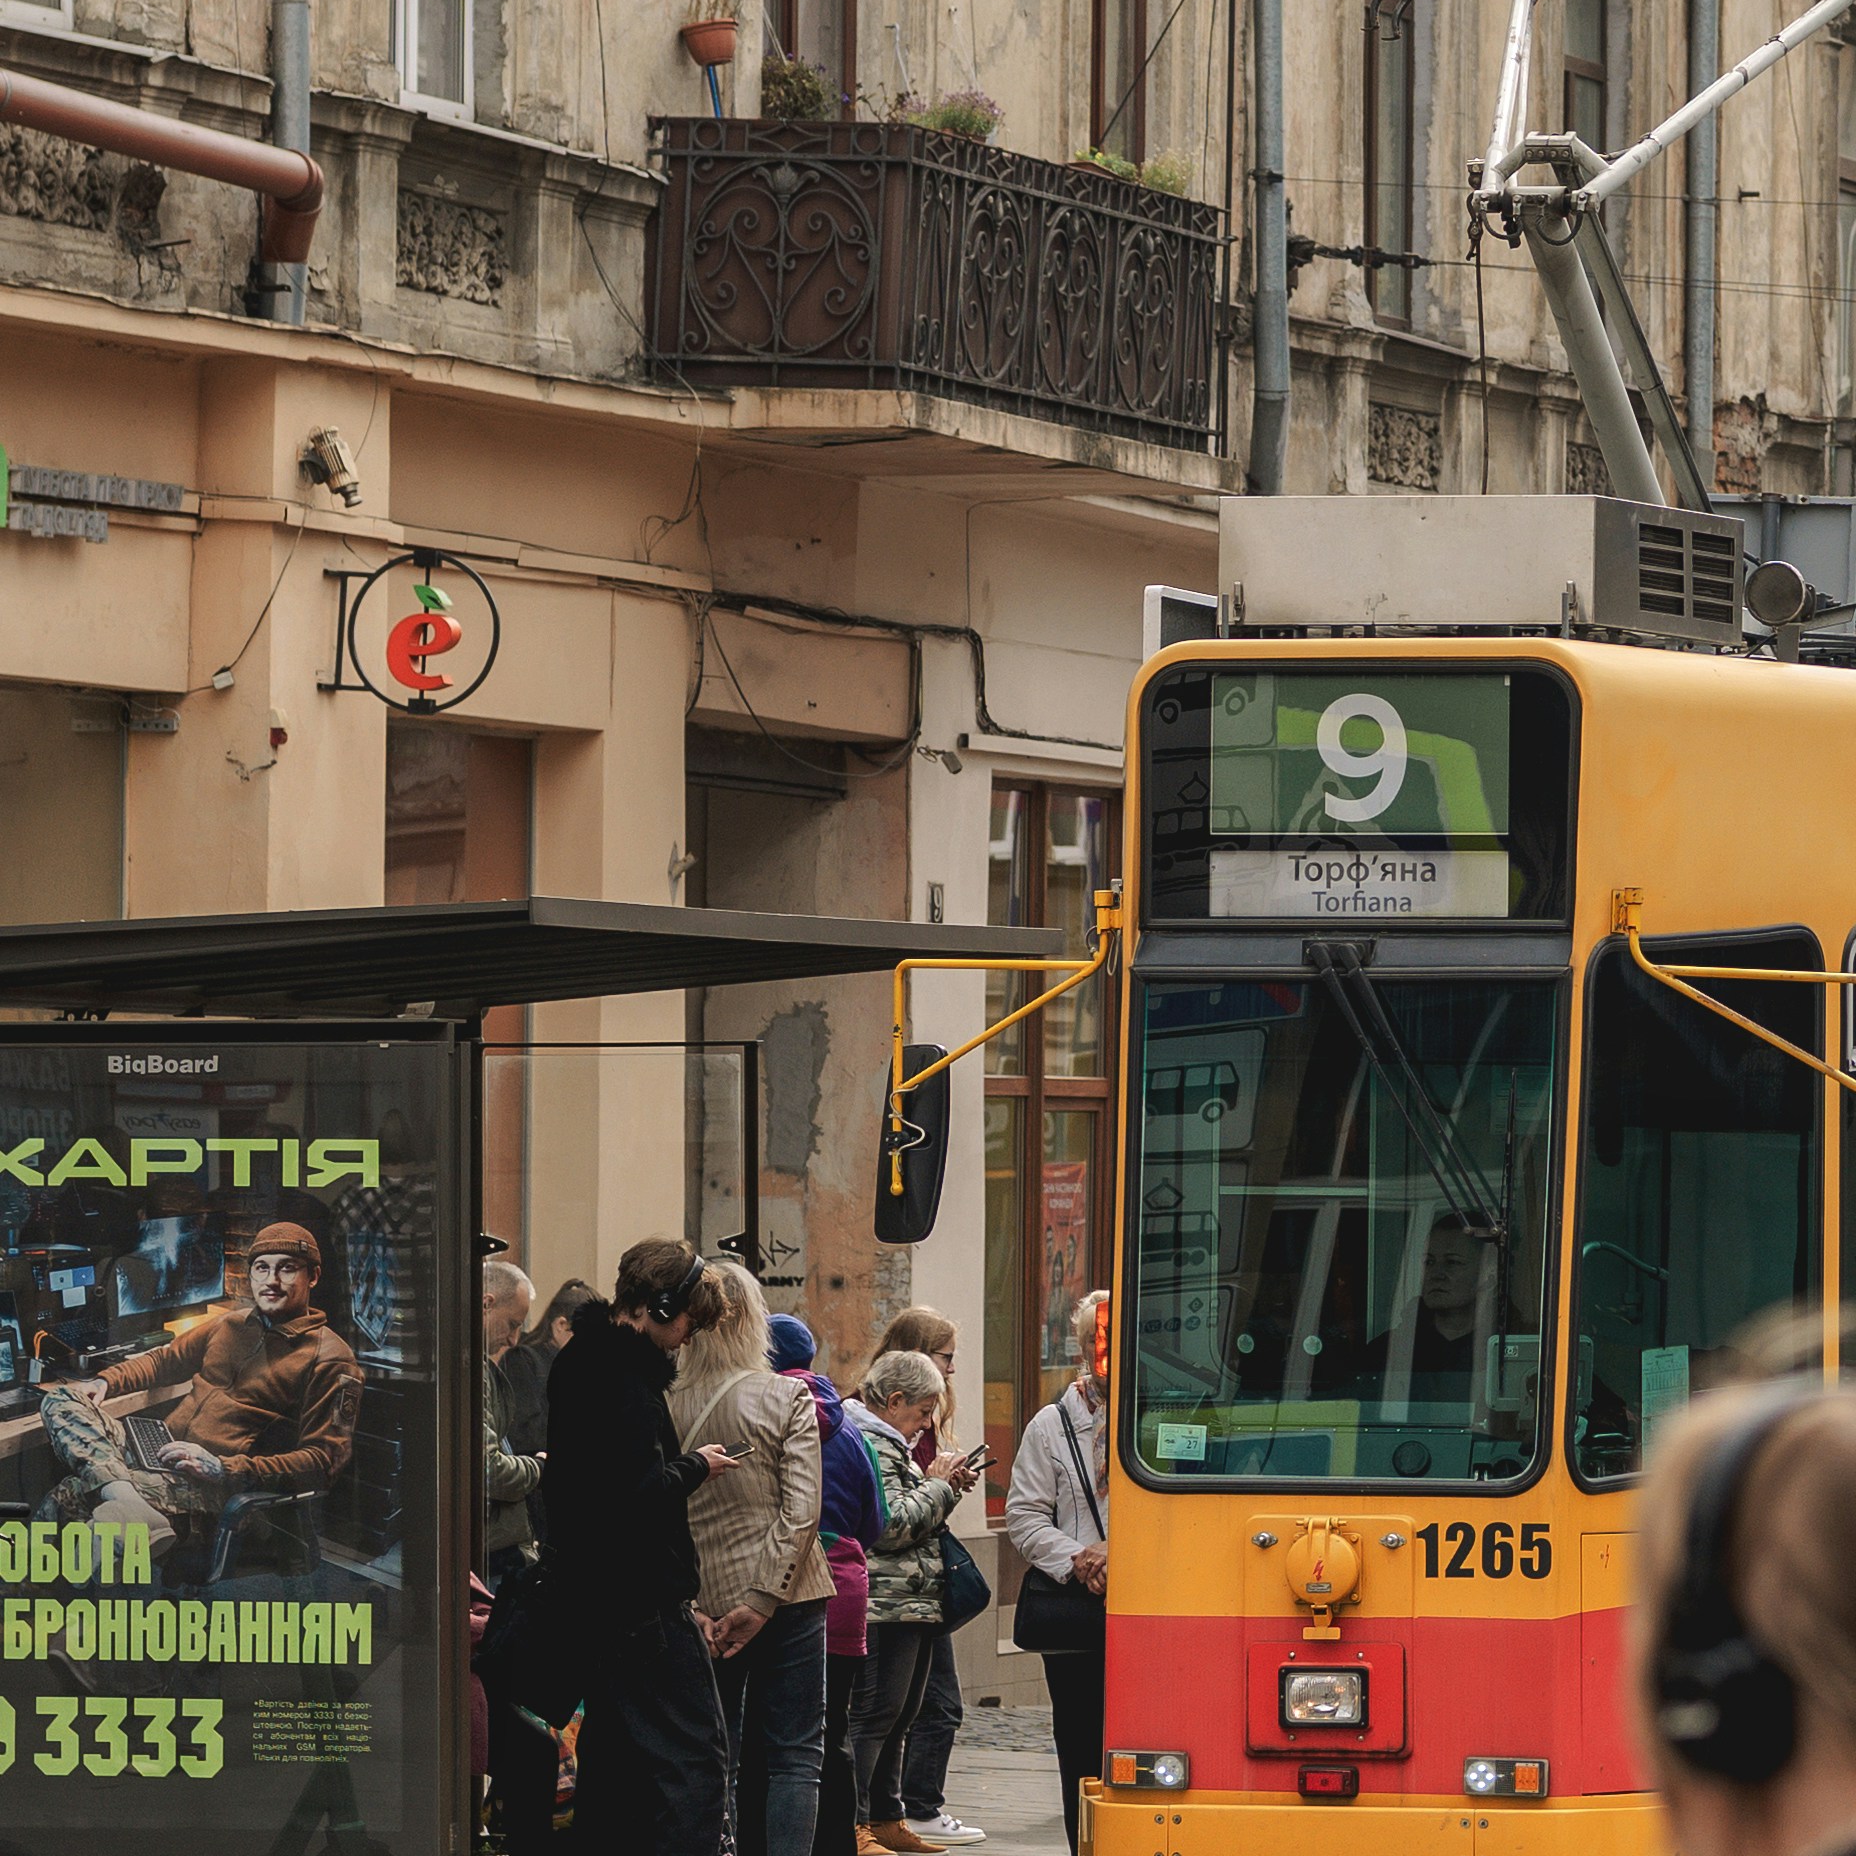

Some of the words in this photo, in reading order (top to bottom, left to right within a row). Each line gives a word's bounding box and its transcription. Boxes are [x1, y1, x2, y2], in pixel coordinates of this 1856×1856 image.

[1317, 693, 1408, 823] 9
[1311, 891, 1413, 914] Torfiana
[107, 1054, 219, 1075] BigBoard
[1186, 1439, 1198, 1450] 27
[1416, 1522, 1551, 1579] 1265
[4, 1599, 372, 1665] БРОНЮВАННЯМ
[34, 1696, 224, 1778] 3333
[296, 1742, 316, 1751] GSM
